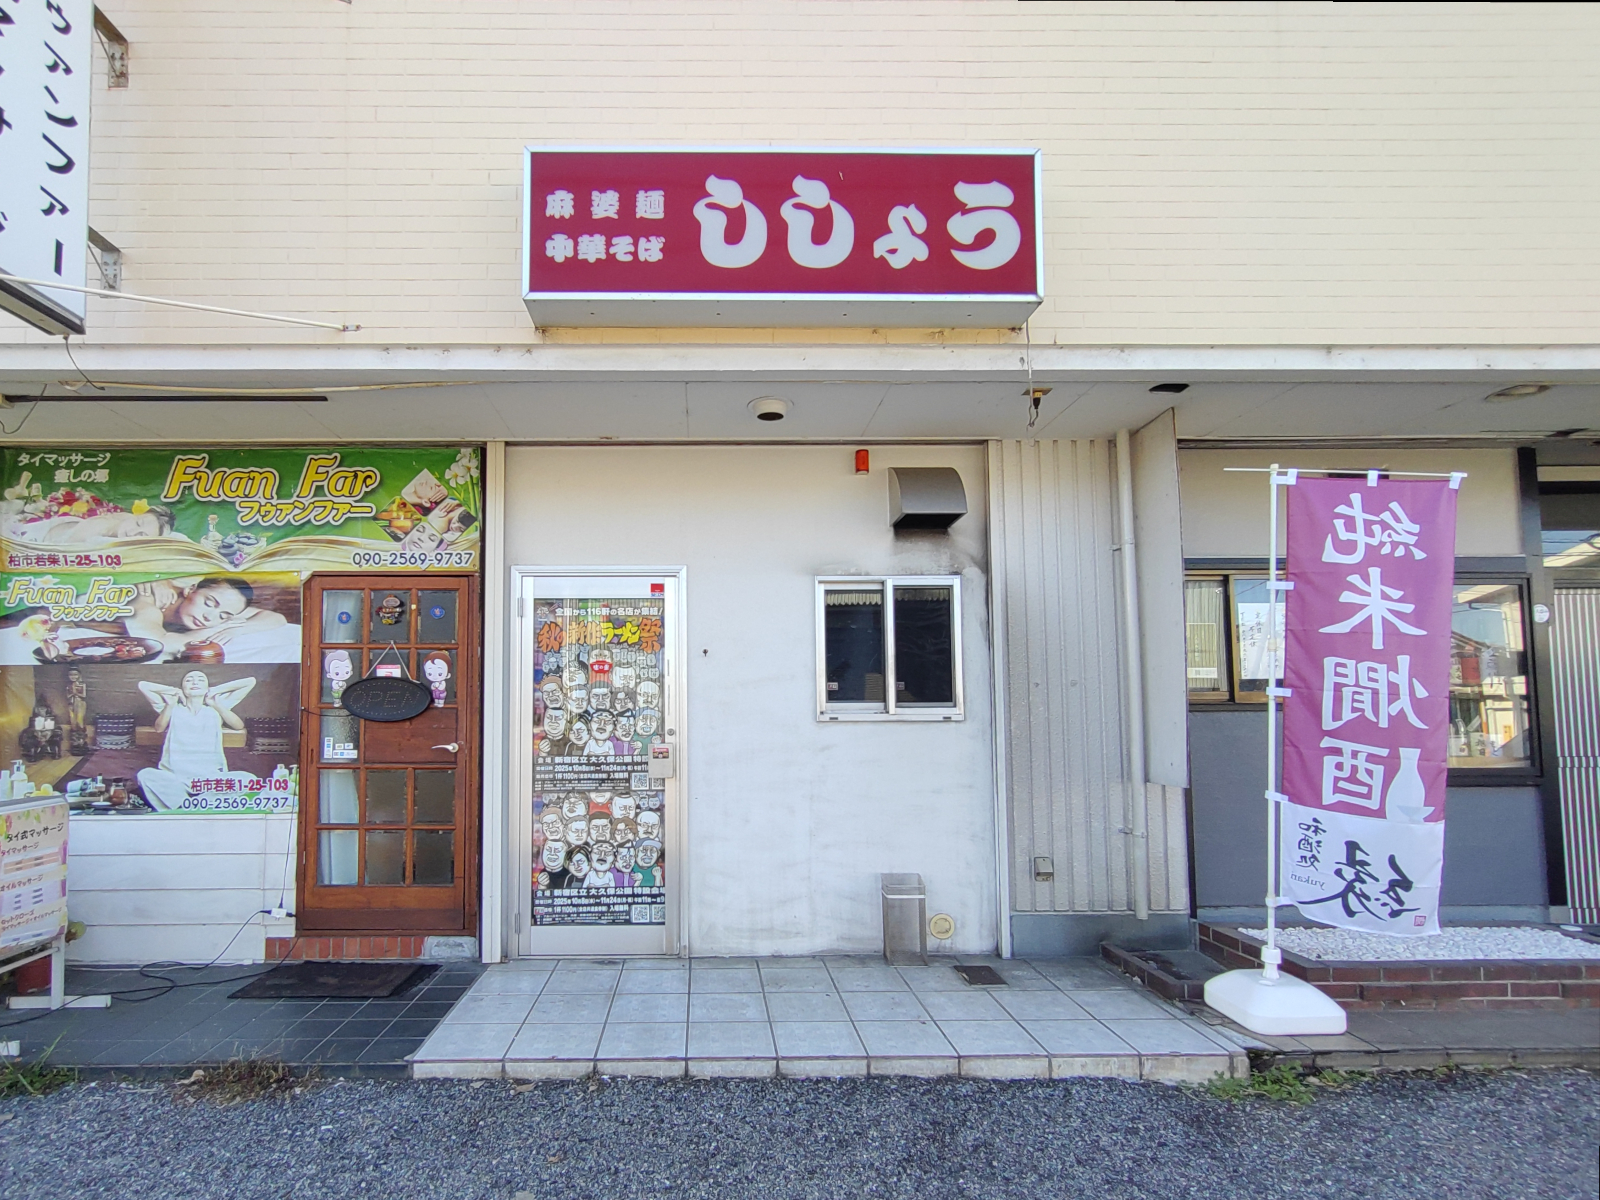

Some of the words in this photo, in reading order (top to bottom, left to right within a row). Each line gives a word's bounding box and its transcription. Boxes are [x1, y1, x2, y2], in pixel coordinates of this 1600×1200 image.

[693, 174, 1021, 270] ししょう
[545, 233, 665, 263] 中華そば
[17, 452, 111, 467] タイマッサージ
[163, 455, 278, 501] Fuan
[298, 454, 378, 500] Far
[352, 551, 474, 566] 090-2569-9737
[8, 578, 74, 605] Fuan
[87, 577, 134, 605] Far
[350, 690, 420, 709] OPEN
[183, 797, 289, 810] 090-2569-9737
[7, 822, 65, 843] タイ式マッサージ
